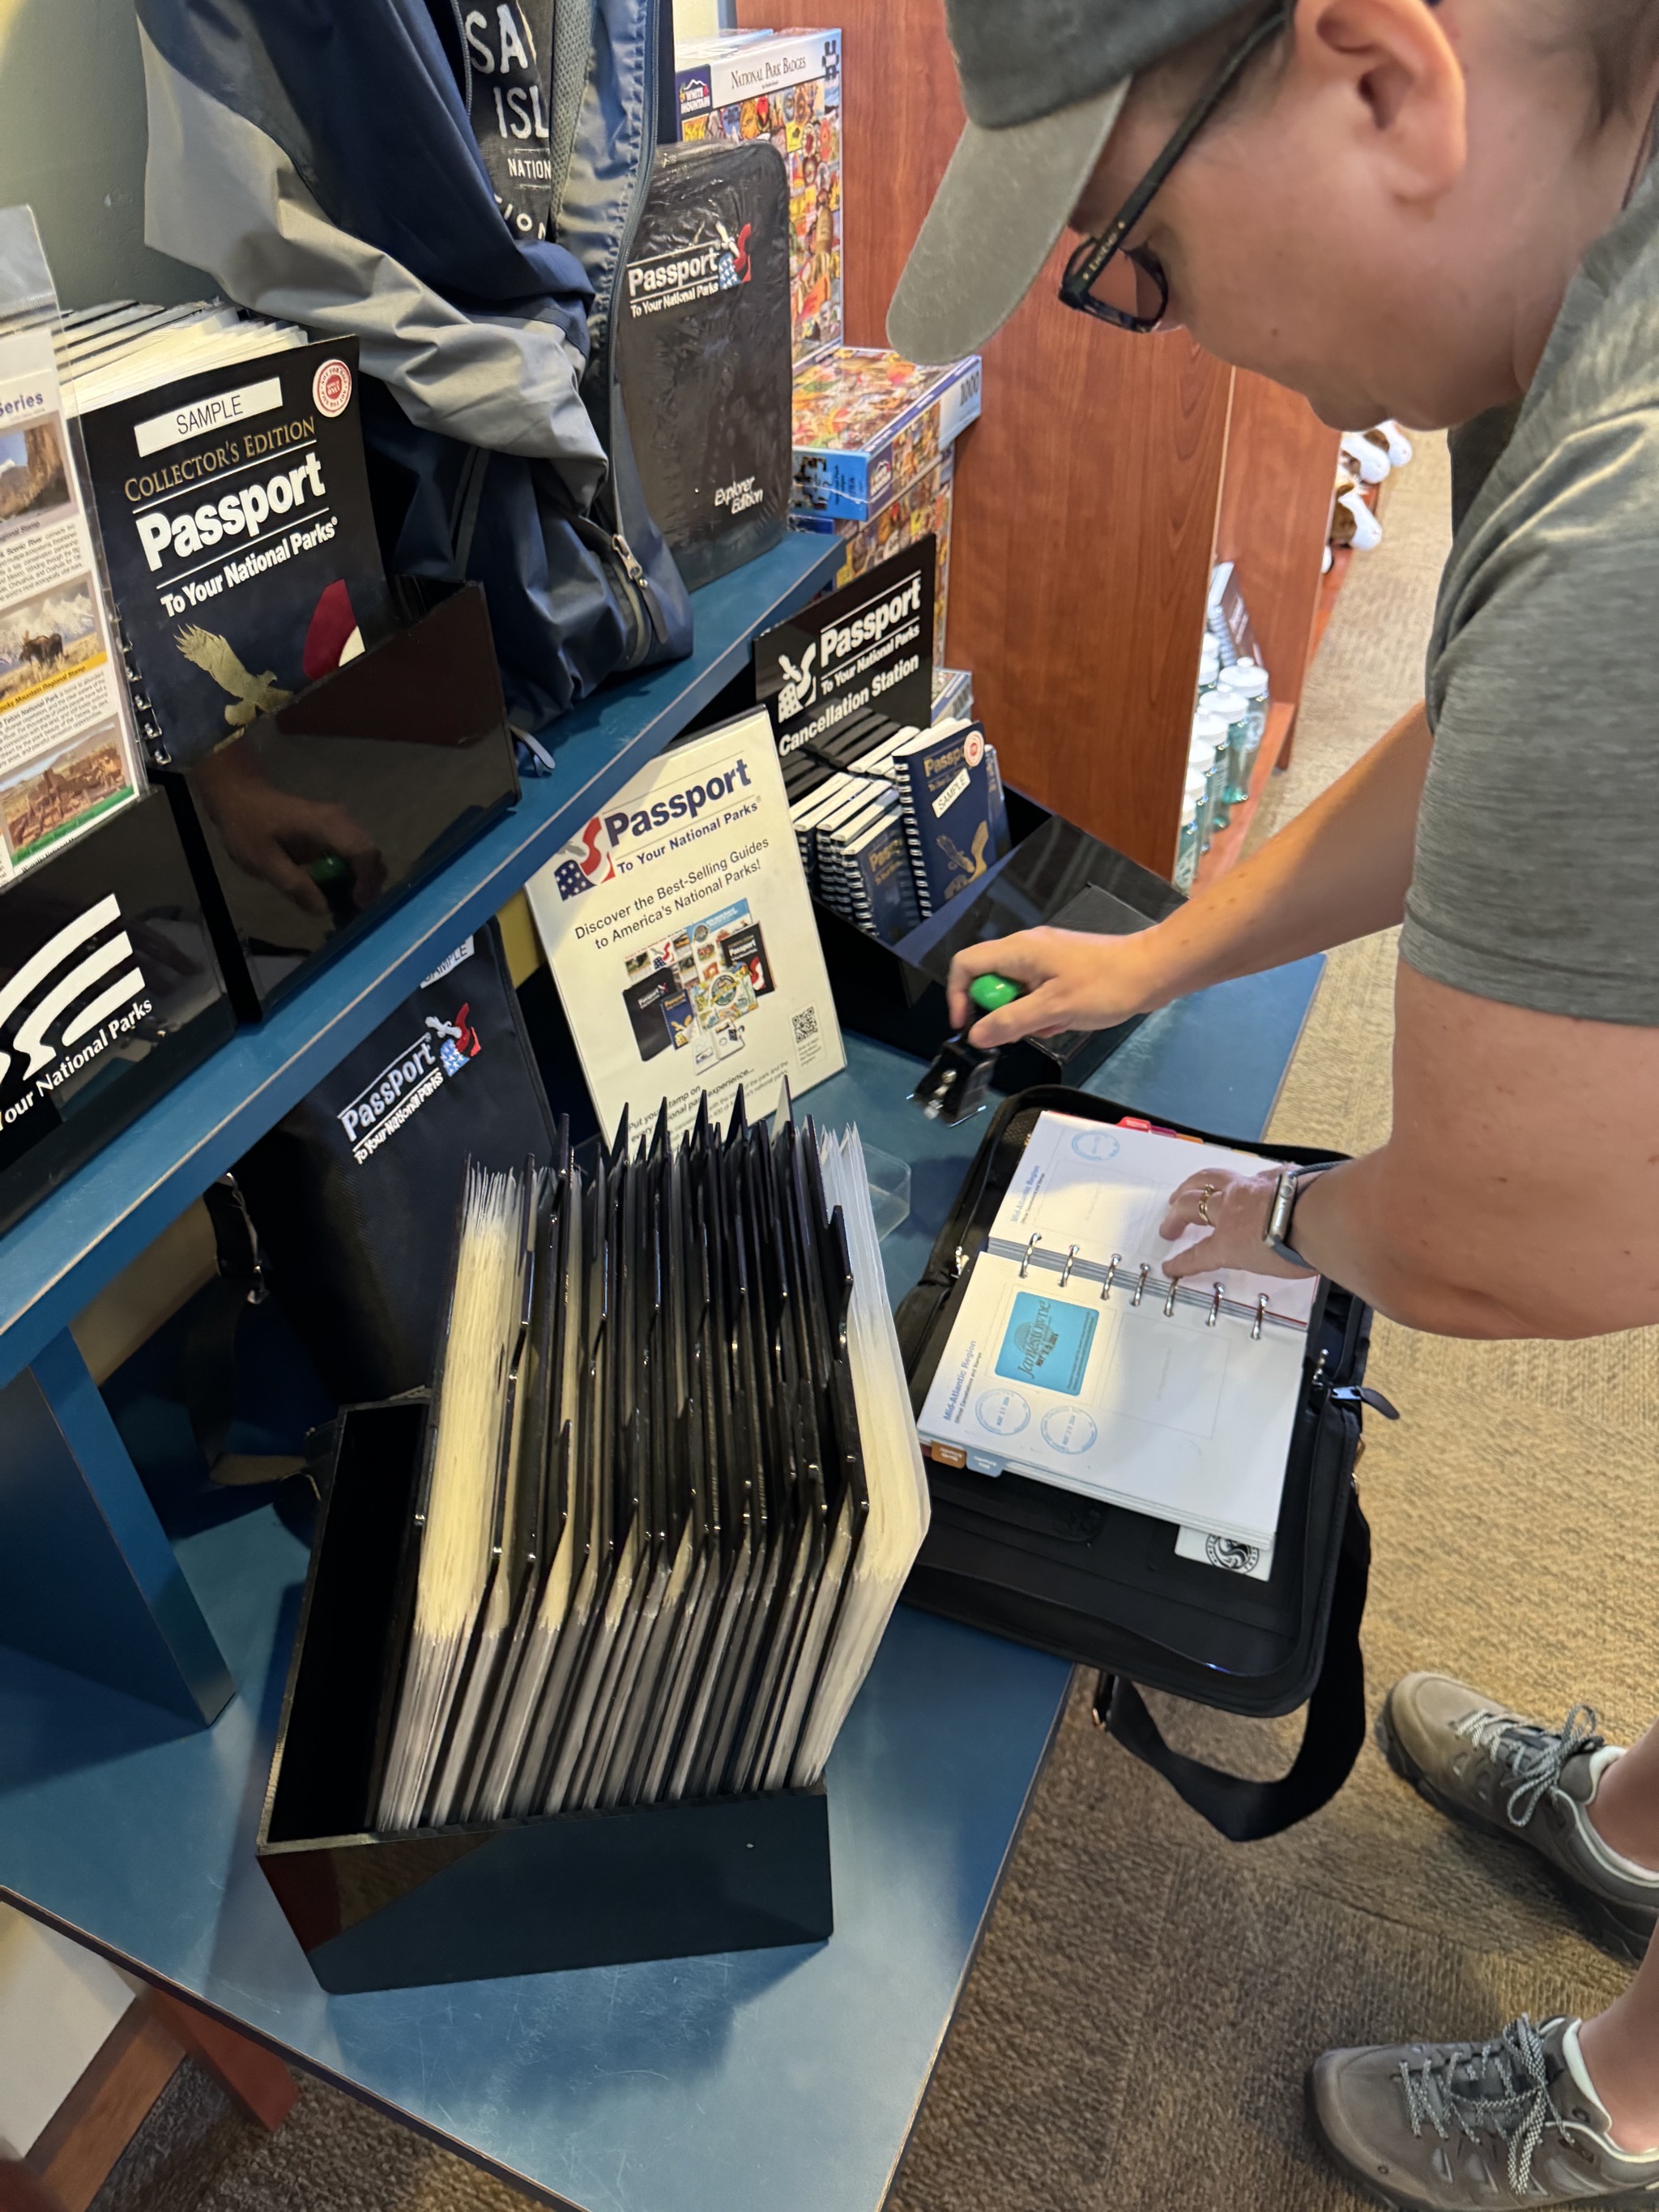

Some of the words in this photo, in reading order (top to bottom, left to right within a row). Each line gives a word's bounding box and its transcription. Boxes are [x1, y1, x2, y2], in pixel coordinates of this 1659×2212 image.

[628, 247, 719, 297] Passport
[630, 305, 642, 318] To
[642, 298, 663, 314] Your
[663, 287, 696, 310] National
[696, 281, 719, 299] Parks
[177, 395, 244, 434] SAMPLE
[125, 440, 240, 502] COLLECTOR'S
[244, 416, 316, 458] EDITION
[714, 476, 755, 506] Explorer
[135, 452, 326, 571] Passport
[731, 488, 763, 514] Edition
[160, 593, 186, 617] To
[181, 573, 224, 606] Your
[224, 538, 291, 587] National
[821, 577, 921, 668] Passport
[821, 680, 834, 695] To
[834, 664, 857, 687] Your
[857, 638, 893, 673] National
[894, 625, 919, 649] Parks
[779, 687, 869, 757] Cancellation
[872, 654, 919, 697] Station
[604, 758, 751, 848] Passport
[938, 774, 966, 810] SAMPLE
[616, 860, 633, 874] To
[636, 846, 665, 865] Your
[669, 818, 721, 850] National
[574, 905, 631, 940] Discover
[633, 895, 655, 911] the
[656, 859, 727, 900] Best-Selling
[730, 838, 770, 864] Guides
[595, 937, 608, 950] to
[612, 906, 672, 942] America's
[674, 878, 723, 911] National
[724, 859, 761, 885] Parks!
[36, 1034, 109, 1097] National
[108, 999, 152, 1040] Parks
[341, 1043, 436, 1142] Passport
[354, 1149, 368, 1164] To
[365, 1128, 387, 1154] Your
[385, 1095, 420, 1135] National
[417, 1072, 443, 1102] Parks
[644, 1109, 660, 1125] you
[667, 1092, 689, 1108] tamp
[690, 1086, 701, 1095] on
[668, 1104, 687, 1121] onal
[943, 1369, 966, 1420] Mid-Atlantic
[961, 1340, 976, 1369] Region
